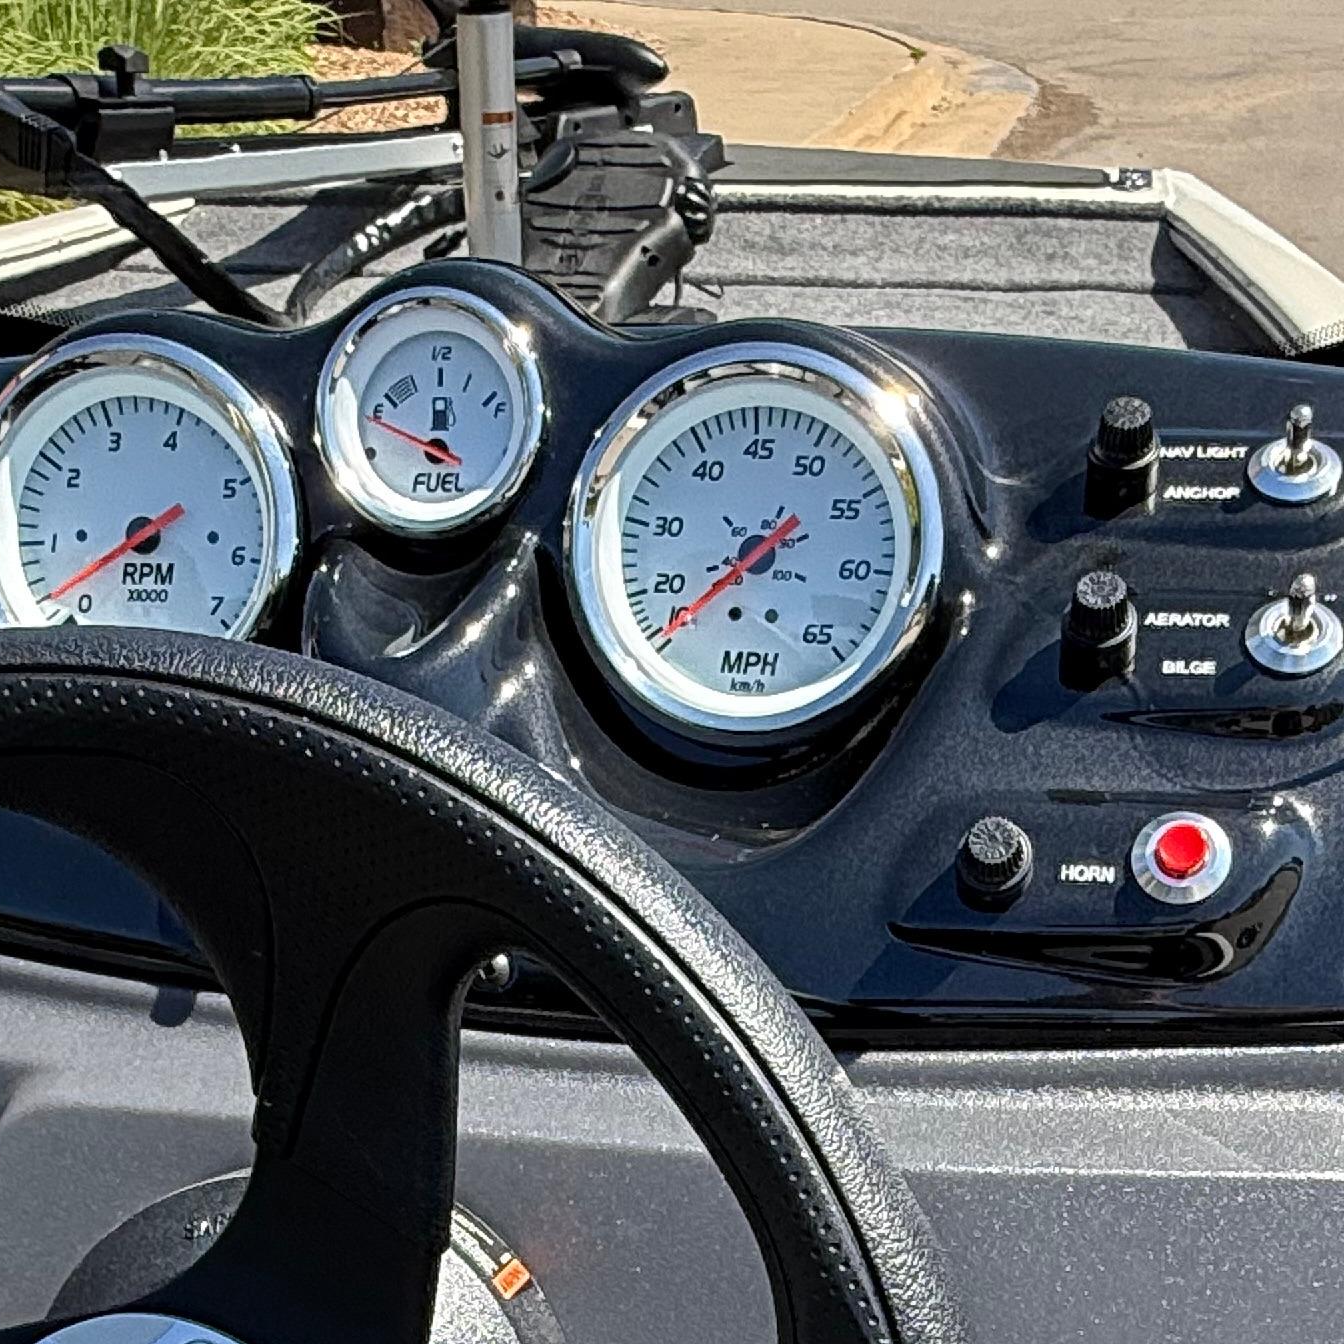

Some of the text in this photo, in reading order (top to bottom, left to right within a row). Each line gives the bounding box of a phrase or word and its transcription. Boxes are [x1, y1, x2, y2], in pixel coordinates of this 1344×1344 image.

[431, 346, 452, 361] 1/2
[373, 403, 384, 421] E
[493, 401, 506, 419] F
[108, 432, 122, 451] 3
[163, 431, 178, 451] 4
[743, 439, 775, 460] 45
[1160, 446, 1248, 459] NAV LIGHT
[692, 461, 724, 481] 40
[792, 456, 825, 476] 50
[66, 468, 81, 488] 2
[412, 473, 464, 492] FUEL
[222, 478, 237, 499] 5
[1163, 486, 1241, 499] ANCHOR
[830, 500, 861, 520] 55
[653, 517, 683, 537] 30
[231, 547, 246, 565] 6
[122, 562, 174, 586] RPM
[838, 560, 871, 580] 60
[654, 574, 685, 594] 20
[78, 594, 92, 613] 0
[210, 596, 224, 615] 7
[1144, 612, 1230, 627] AERATOR
[802, 625, 833, 644] 65
[721, 651, 779, 676] MPH
[1162, 660, 1216, 674] BILGE
[729, 677, 765, 692] km/h
[1060, 864, 1116, 883] HORN
